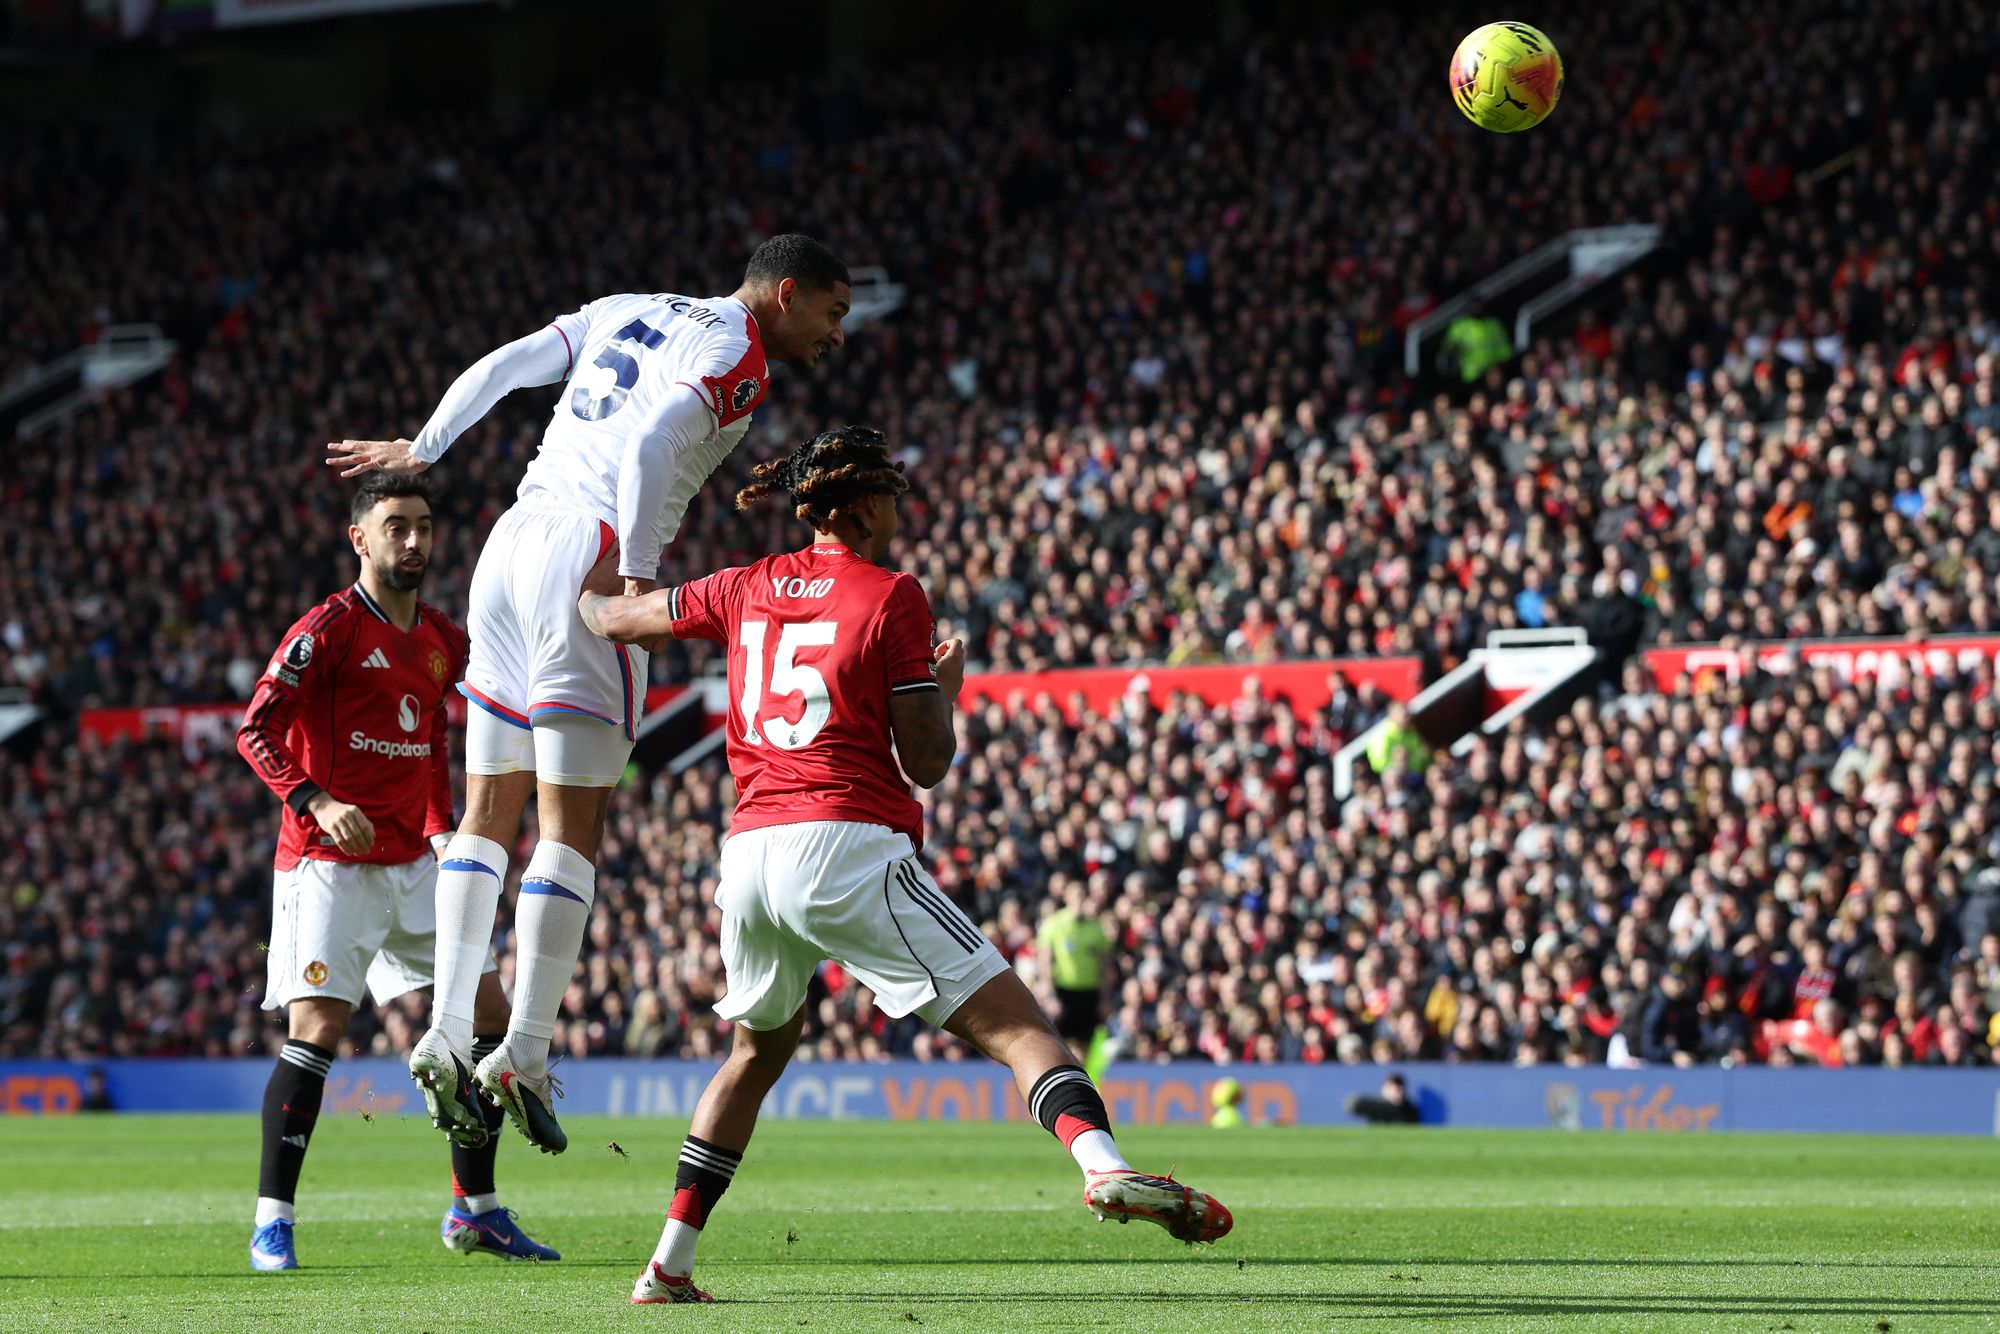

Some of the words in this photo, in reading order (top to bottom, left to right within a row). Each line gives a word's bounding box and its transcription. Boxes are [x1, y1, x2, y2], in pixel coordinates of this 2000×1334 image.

[570, 318, 668, 422] 5
[772, 576, 836, 599] YORO
[740, 621, 838, 751] 15
